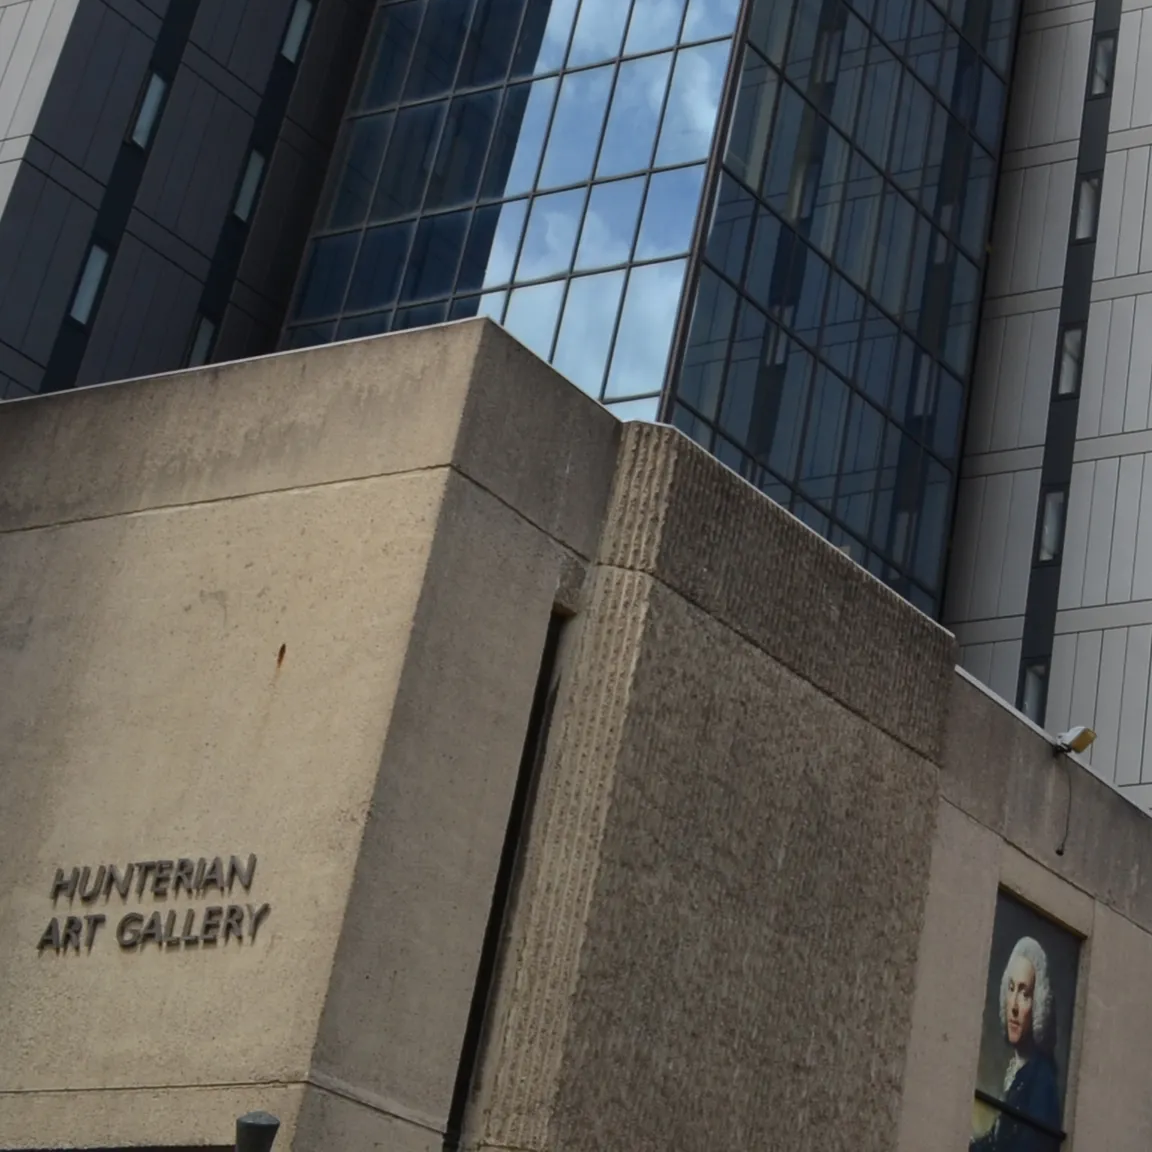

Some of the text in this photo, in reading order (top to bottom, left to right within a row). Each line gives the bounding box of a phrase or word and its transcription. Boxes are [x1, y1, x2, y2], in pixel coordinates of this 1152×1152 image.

[52, 853, 257, 905] HUNTERIAN
[37, 902, 271, 956] ART GALLERY
